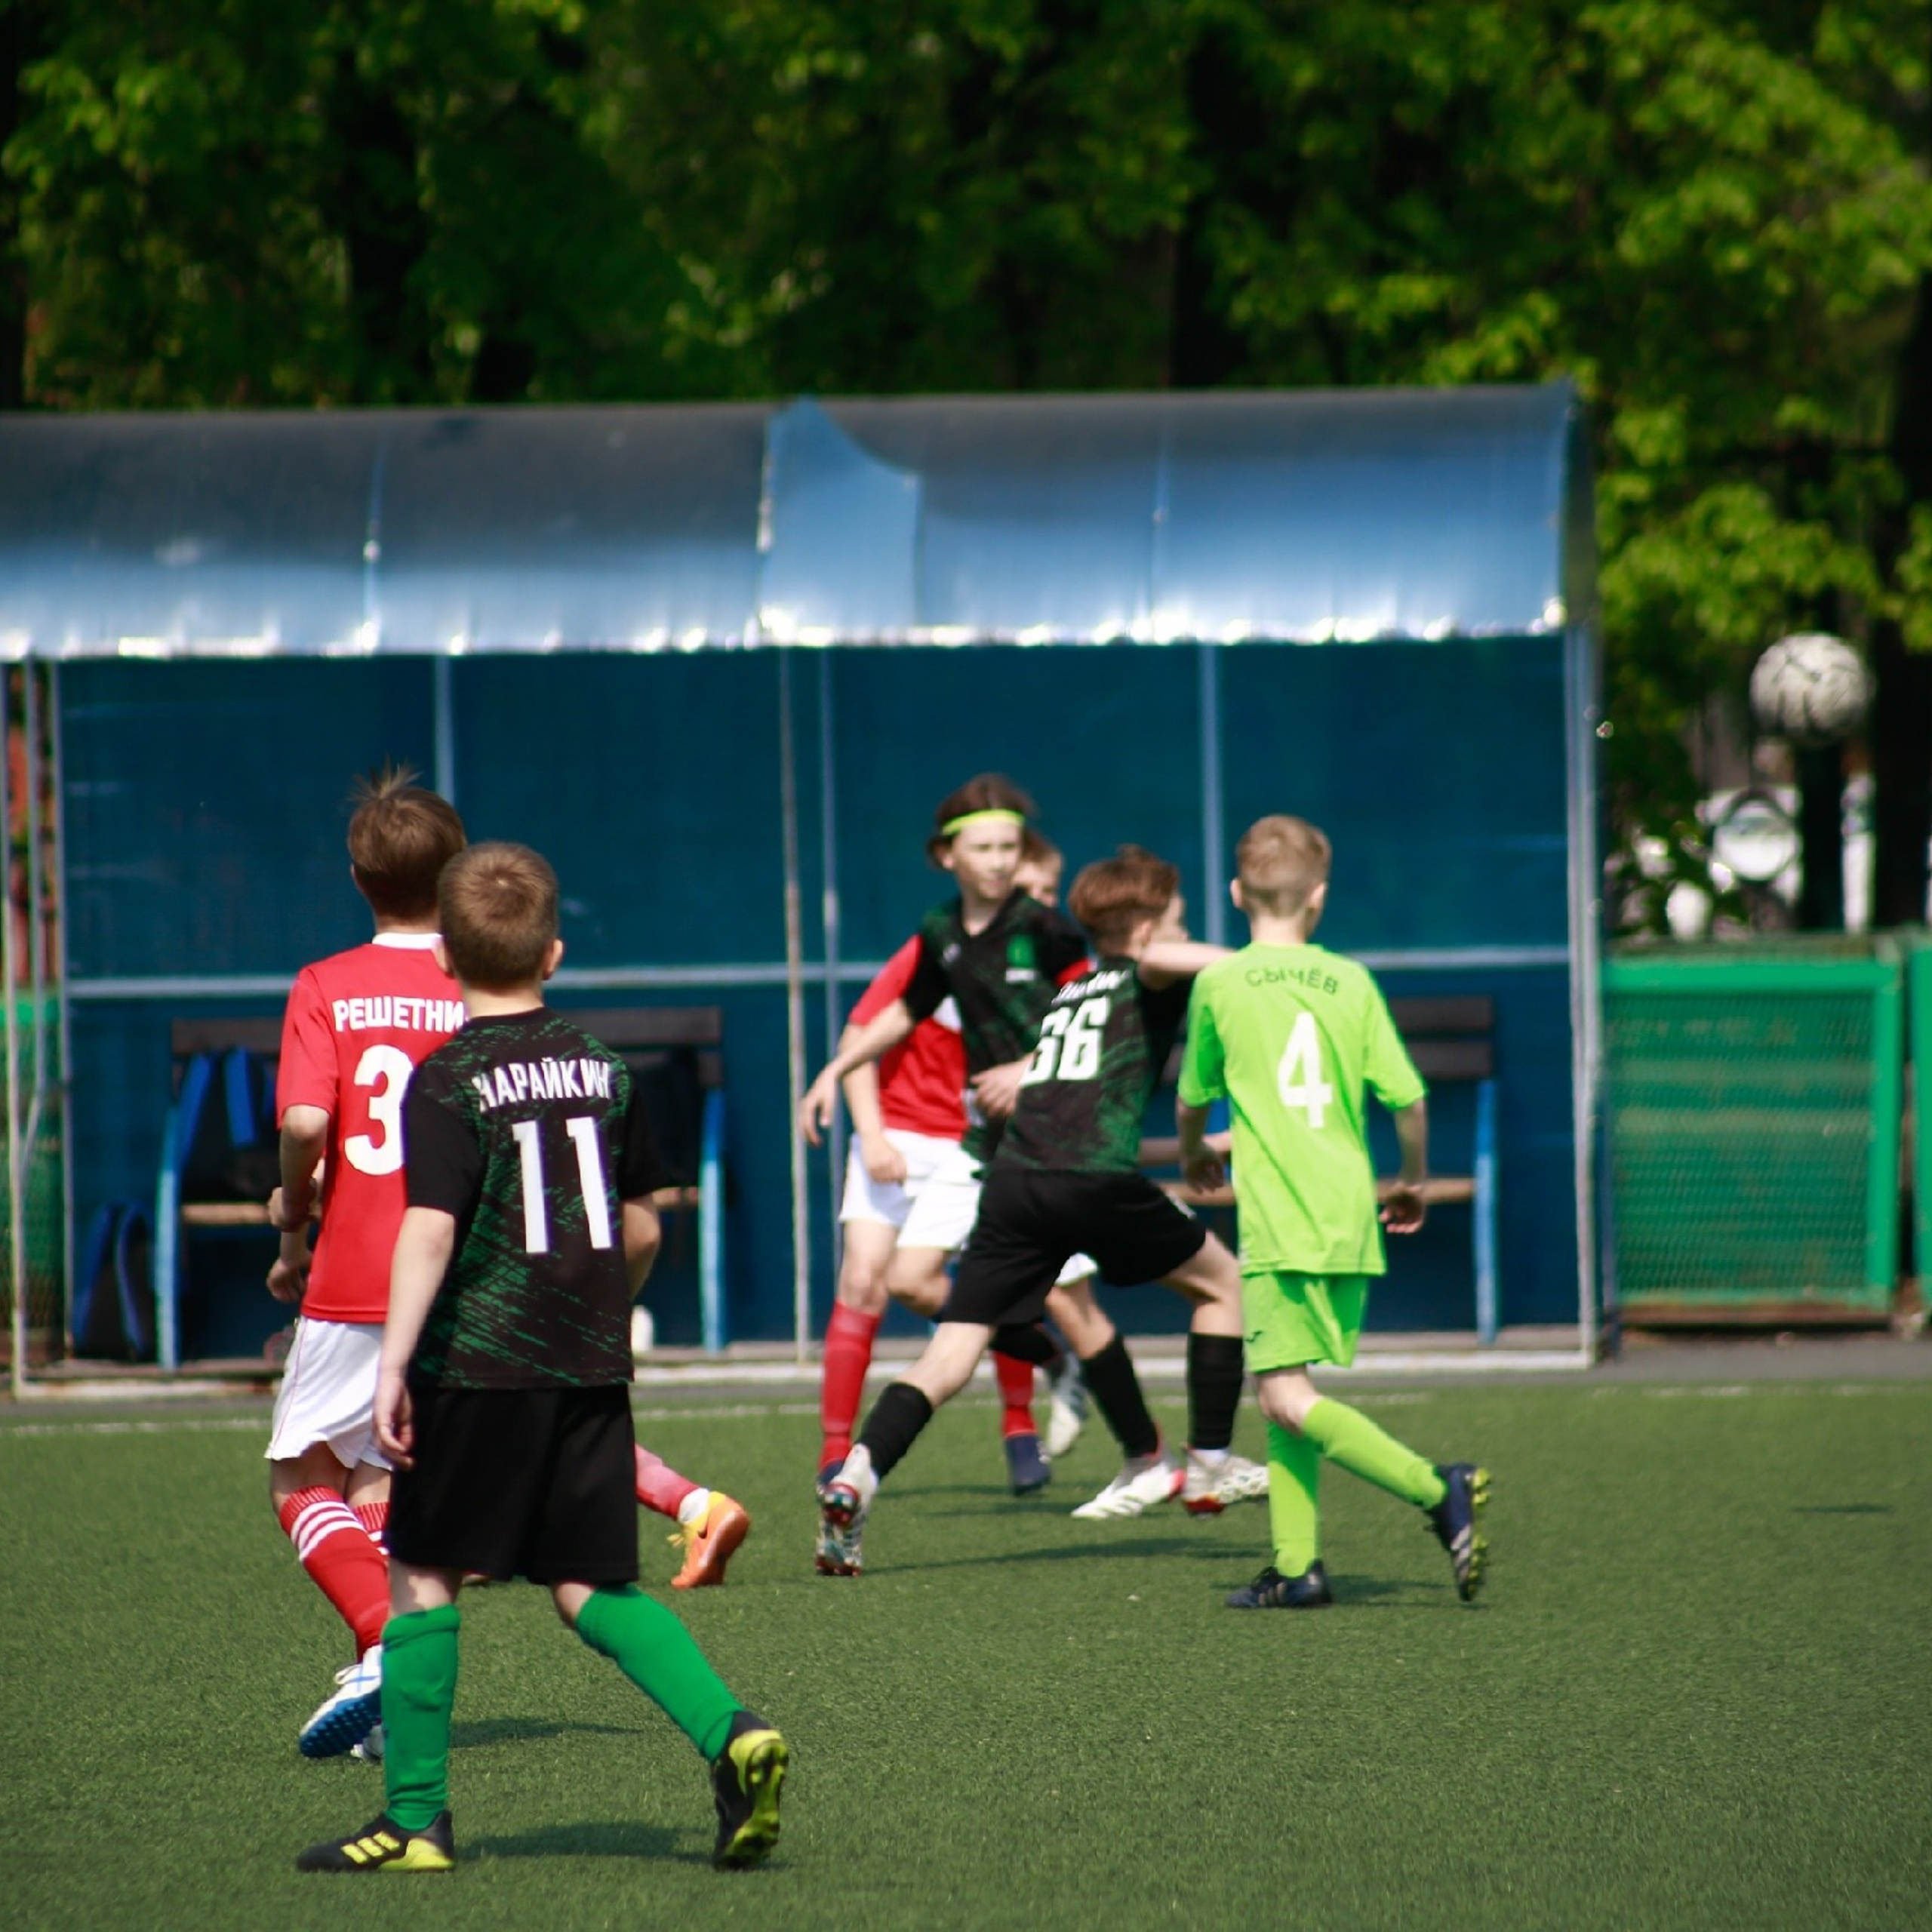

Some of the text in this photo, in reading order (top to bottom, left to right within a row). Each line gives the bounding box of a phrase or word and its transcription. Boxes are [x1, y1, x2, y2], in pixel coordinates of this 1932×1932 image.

[333, 996, 466, 1033] РЕШЕТНИ
[1244, 967, 1339, 995] СЫЧЁВ
[345, 1044, 414, 1176] 3
[1277, 1011, 1333, 1129] 4
[512, 1117, 611, 1254] 11
